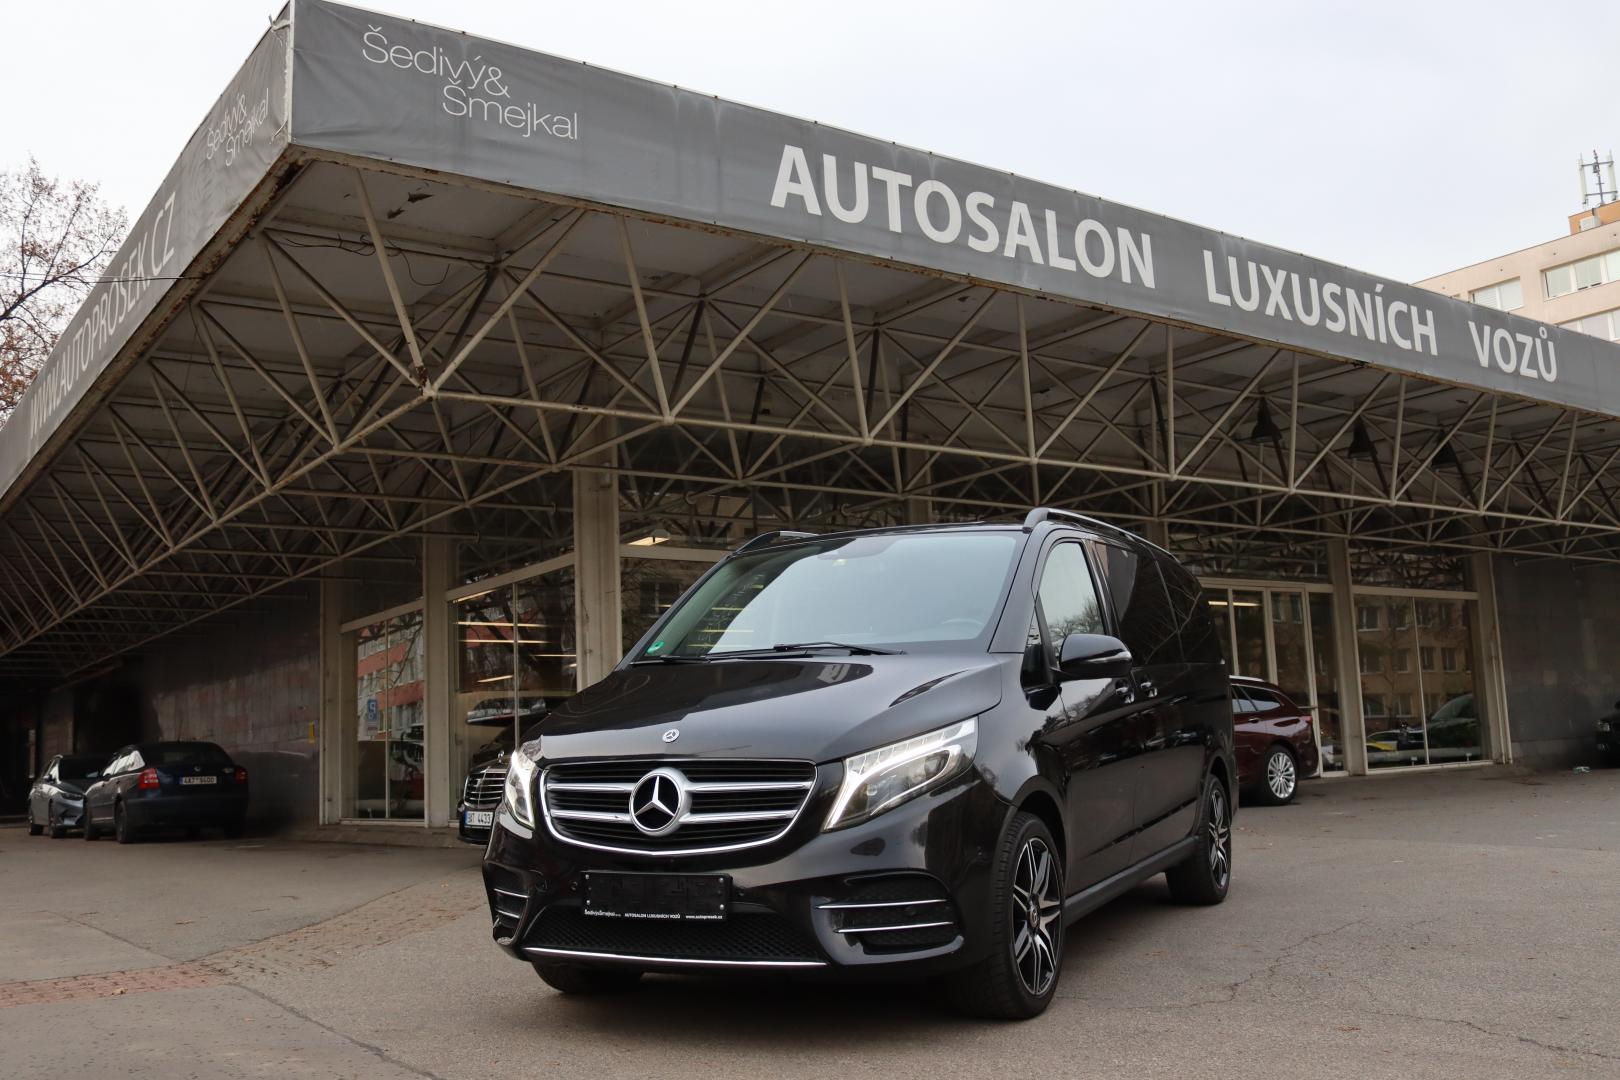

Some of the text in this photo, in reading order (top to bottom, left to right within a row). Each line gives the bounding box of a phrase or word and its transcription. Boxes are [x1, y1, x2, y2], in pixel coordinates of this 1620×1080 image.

[442, 77, 578, 140] Šmejkal
[770, 144, 1558, 382] AUTOSALON LUXUSNÍCH VOZŮ
